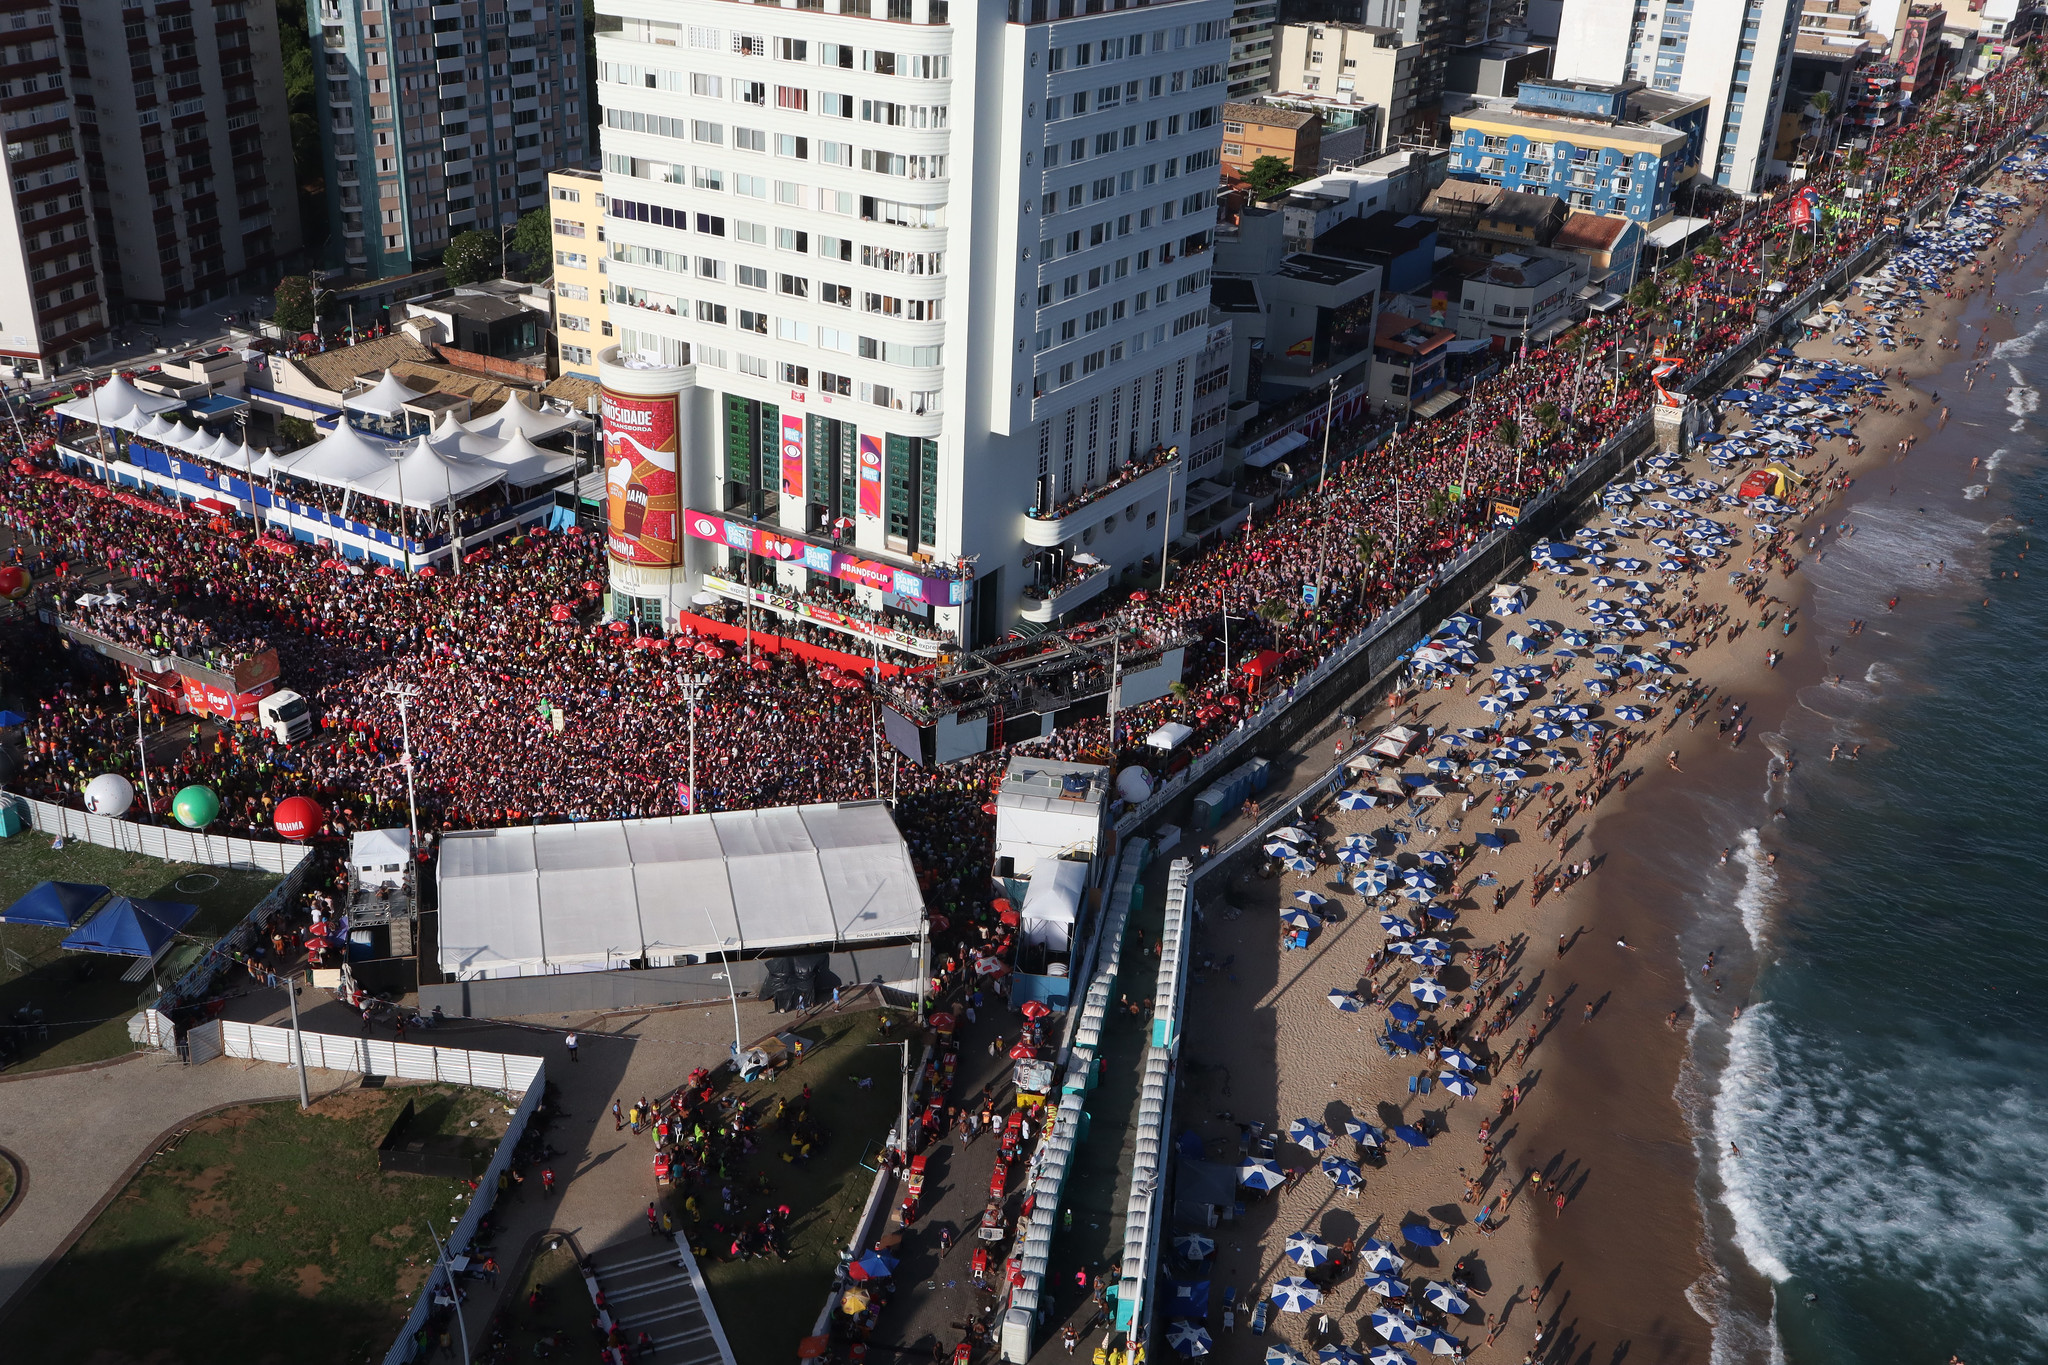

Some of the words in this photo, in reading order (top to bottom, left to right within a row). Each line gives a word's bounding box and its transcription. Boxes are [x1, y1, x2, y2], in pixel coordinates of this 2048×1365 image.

[609, 420, 653, 432] TRANSBORDA
[806, 548, 829, 563] BAND
[807, 558, 830, 572] FOLIA
[840, 562, 888, 583] #BANDFOLIA
[895, 572, 920, 587] BAND
[896, 582, 920, 597] FOLIA
[275, 820, 304, 833] BRAHMA
